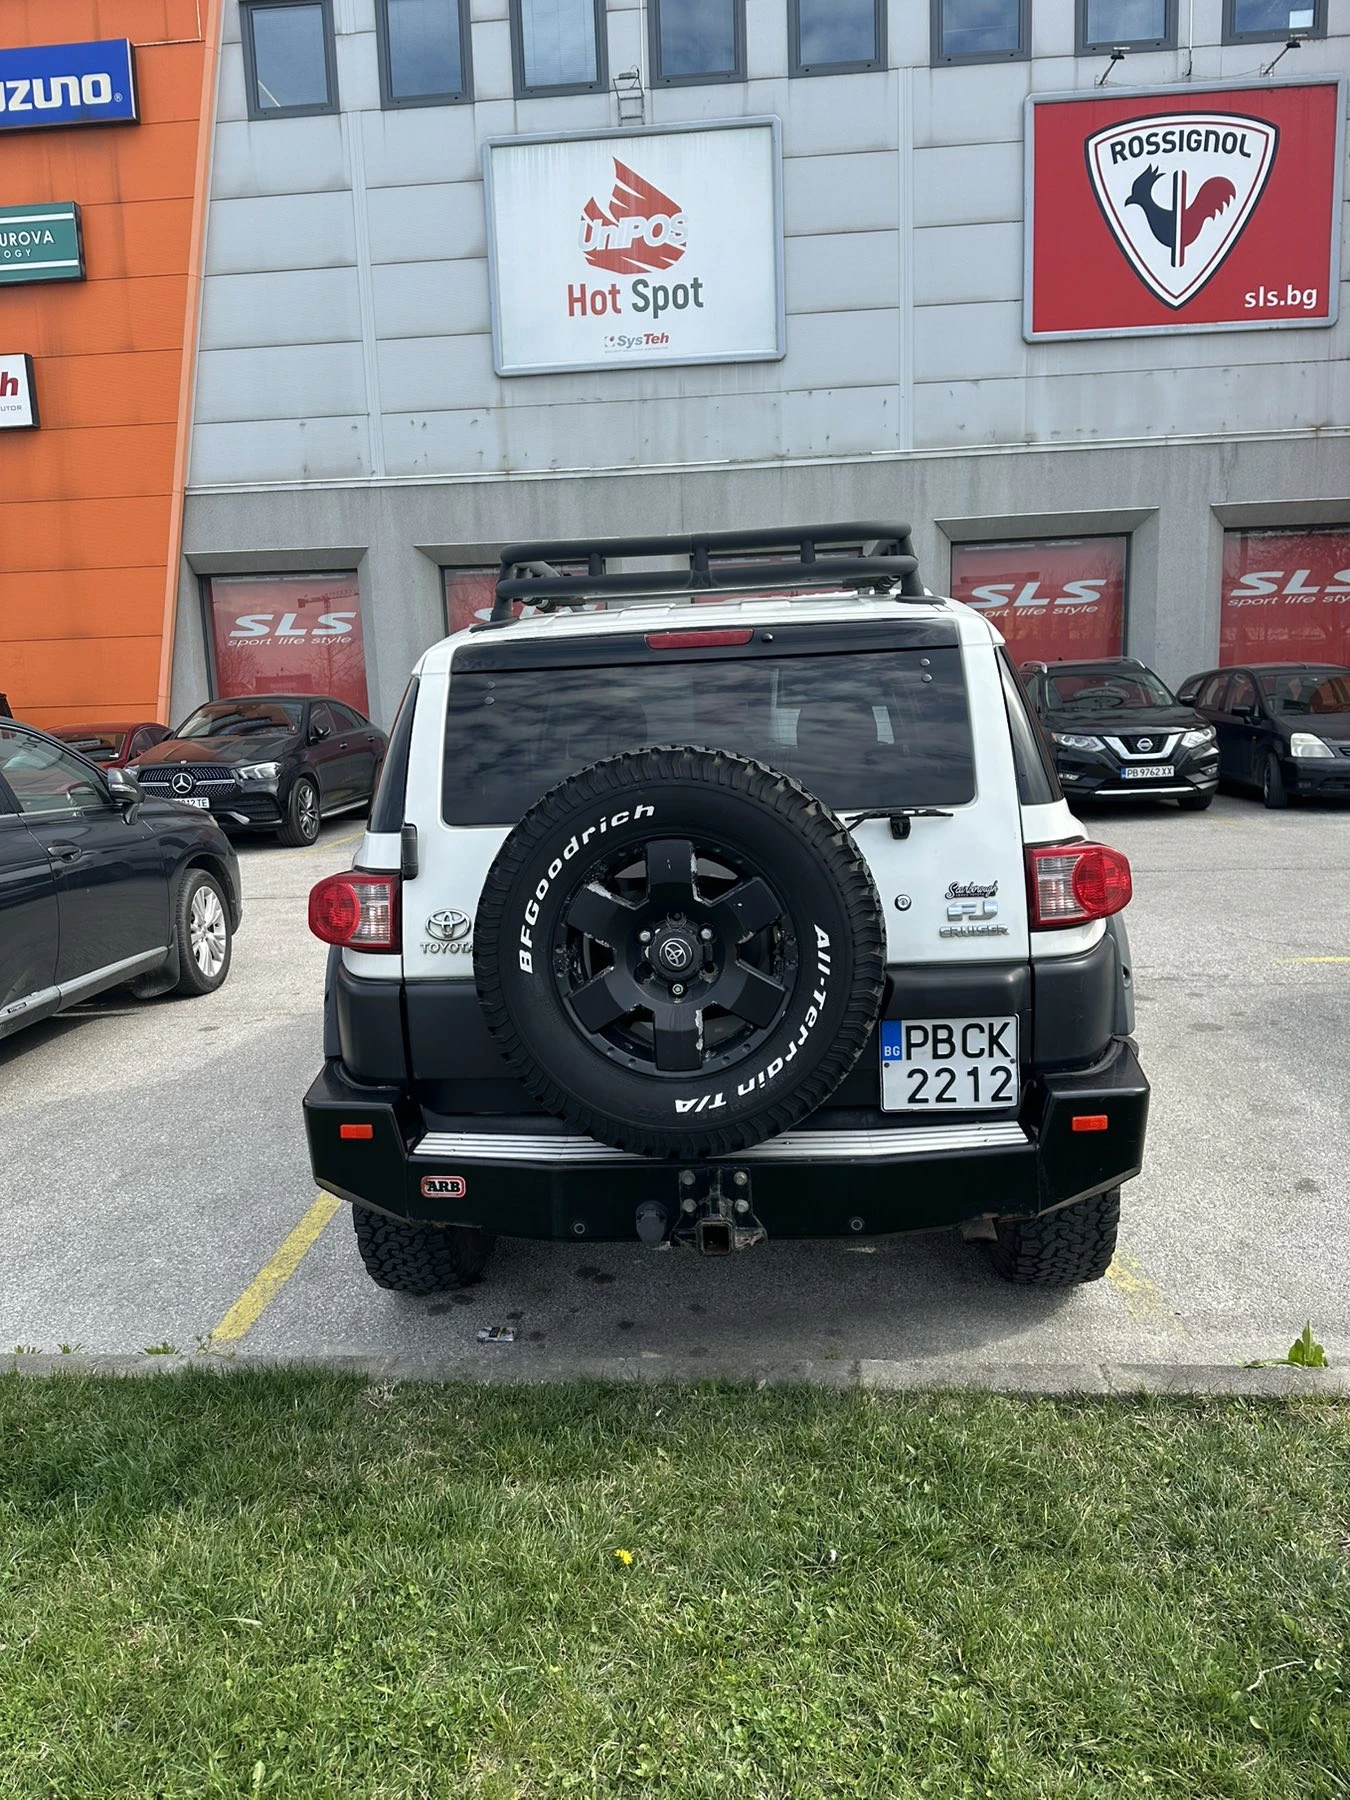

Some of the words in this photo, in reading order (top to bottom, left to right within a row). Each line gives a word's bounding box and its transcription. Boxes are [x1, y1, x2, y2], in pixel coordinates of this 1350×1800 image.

[1110, 129, 1252, 165] ROSSIGNOL
[578, 212, 689, 250] UniPOS
[568, 283, 622, 317] Hot
[631, 277, 704, 319] Spot
[1244, 285, 1317, 309] sls.bg
[617, 332, 669, 349] SysTeh
[966, 579, 1107, 609] SLS
[1227, 596, 1278, 608] sport
[1285, 594, 1317, 604] life
[1016, 606, 1046, 617] life
[1053, 604, 1098, 616] style
[229, 612, 357, 637] SLS
[228, 637, 272, 648] sport
[278, 635, 305, 645] life
[311, 635, 352, 646] style
[1127, 769, 1139, 778] PB
[1140, 768, 1160, 777] 9762
[1161, 767, 1173, 776] XX
[519, 805, 655, 974] BFGoodrich
[939, 924, 1010, 938] CRUISER
[737, 924, 831, 1096] All-Terrain
[884, 1046, 900, 1057] BG
[905, 1022, 1012, 1061] PBCK
[907, 1066, 1013, 1104] 2212
[675, 1092, 727, 1113] T/A
[426, 1180, 461, 1192] ARB
